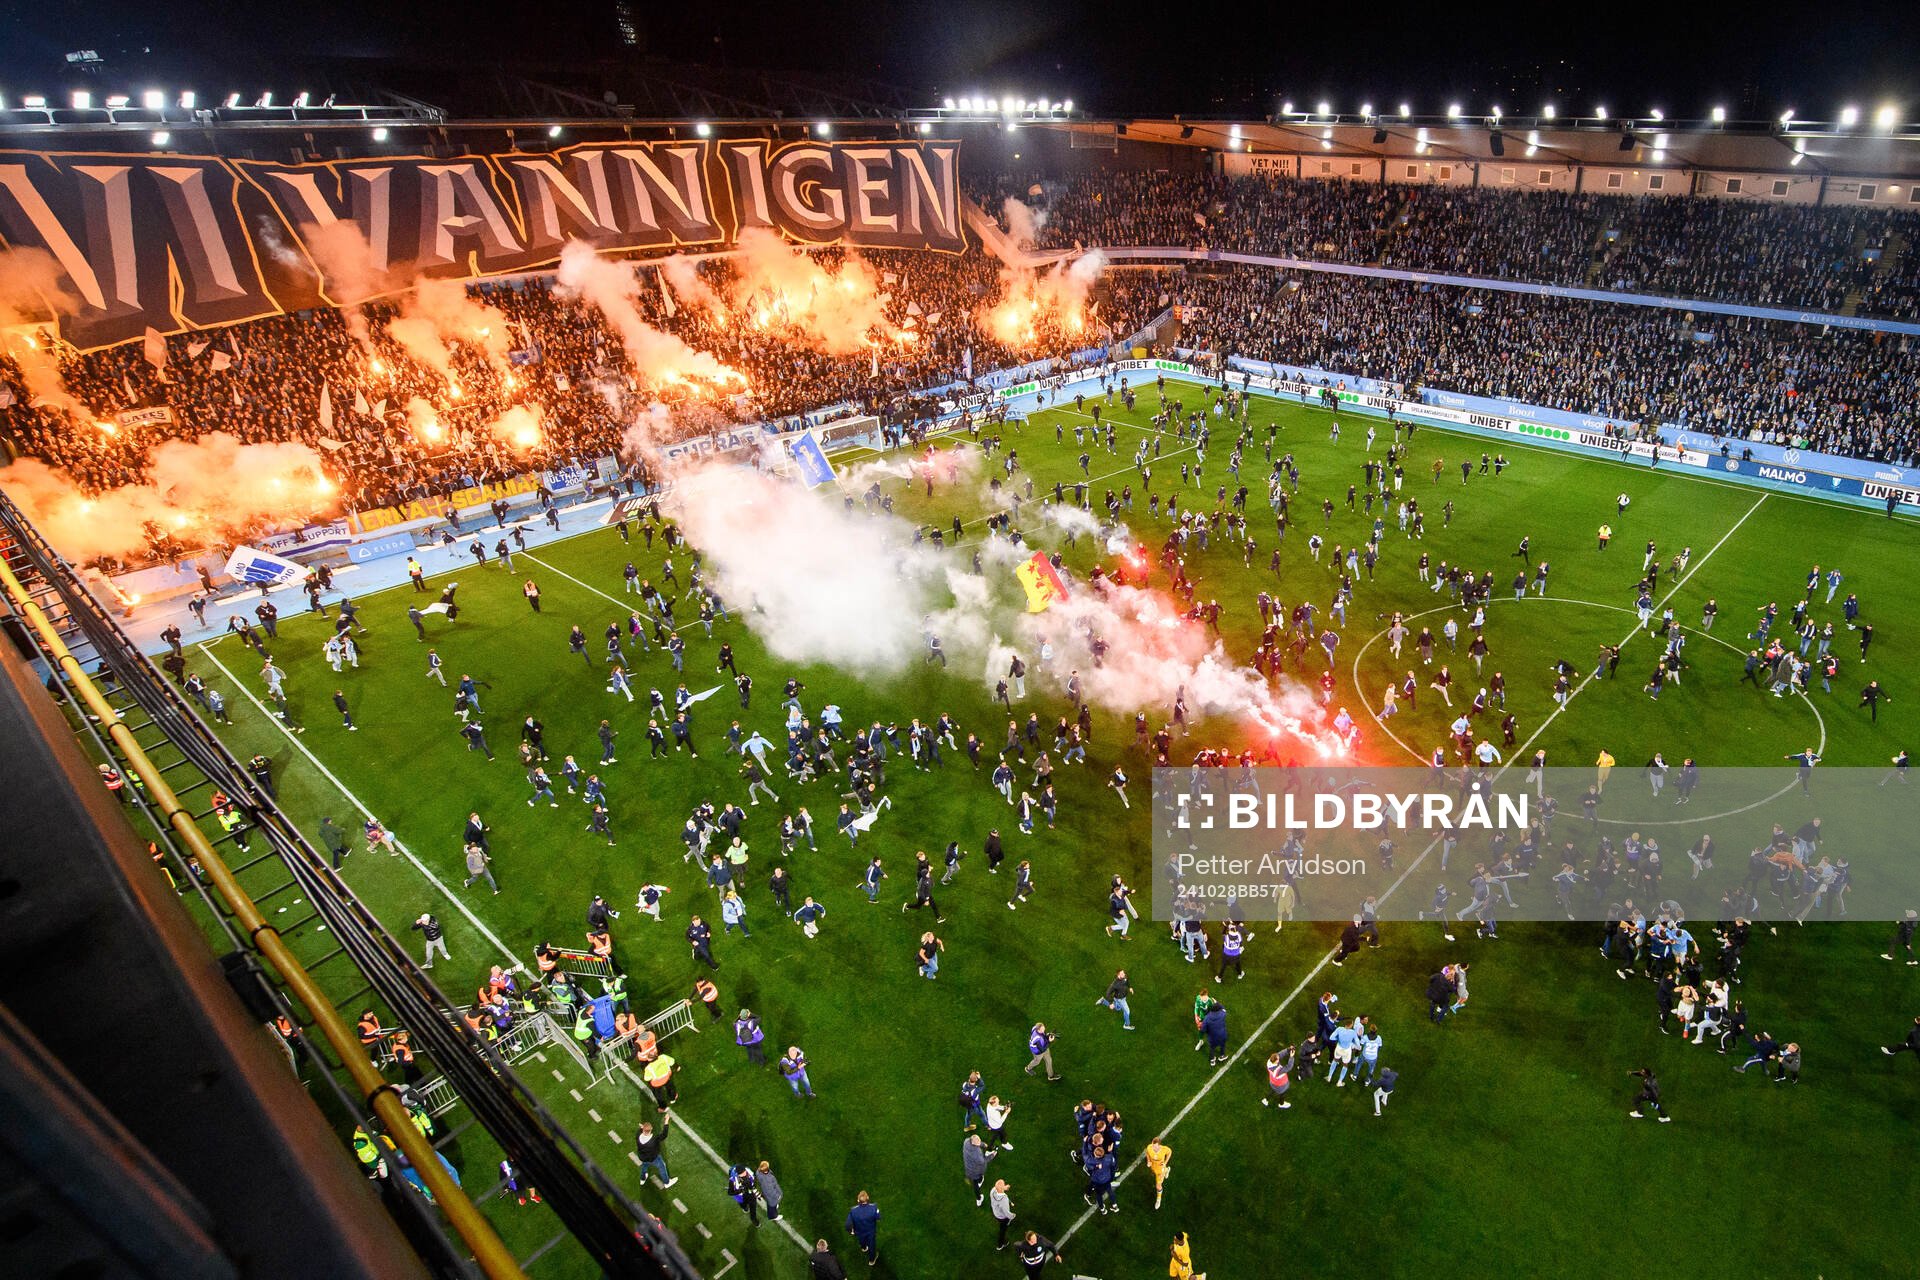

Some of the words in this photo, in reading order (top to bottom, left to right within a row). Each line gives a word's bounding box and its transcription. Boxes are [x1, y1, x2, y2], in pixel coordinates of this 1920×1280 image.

[1251, 159, 1269, 168] VET
[0, 164, 248, 320] VI
[266, 147, 711, 275] VANN
[731, 147, 959, 240] IGEN
[1508, 405, 1536, 418] Boozt
[1470, 415, 1511, 430] UNIBET
[1758, 467, 1807, 483] MALMÖ
